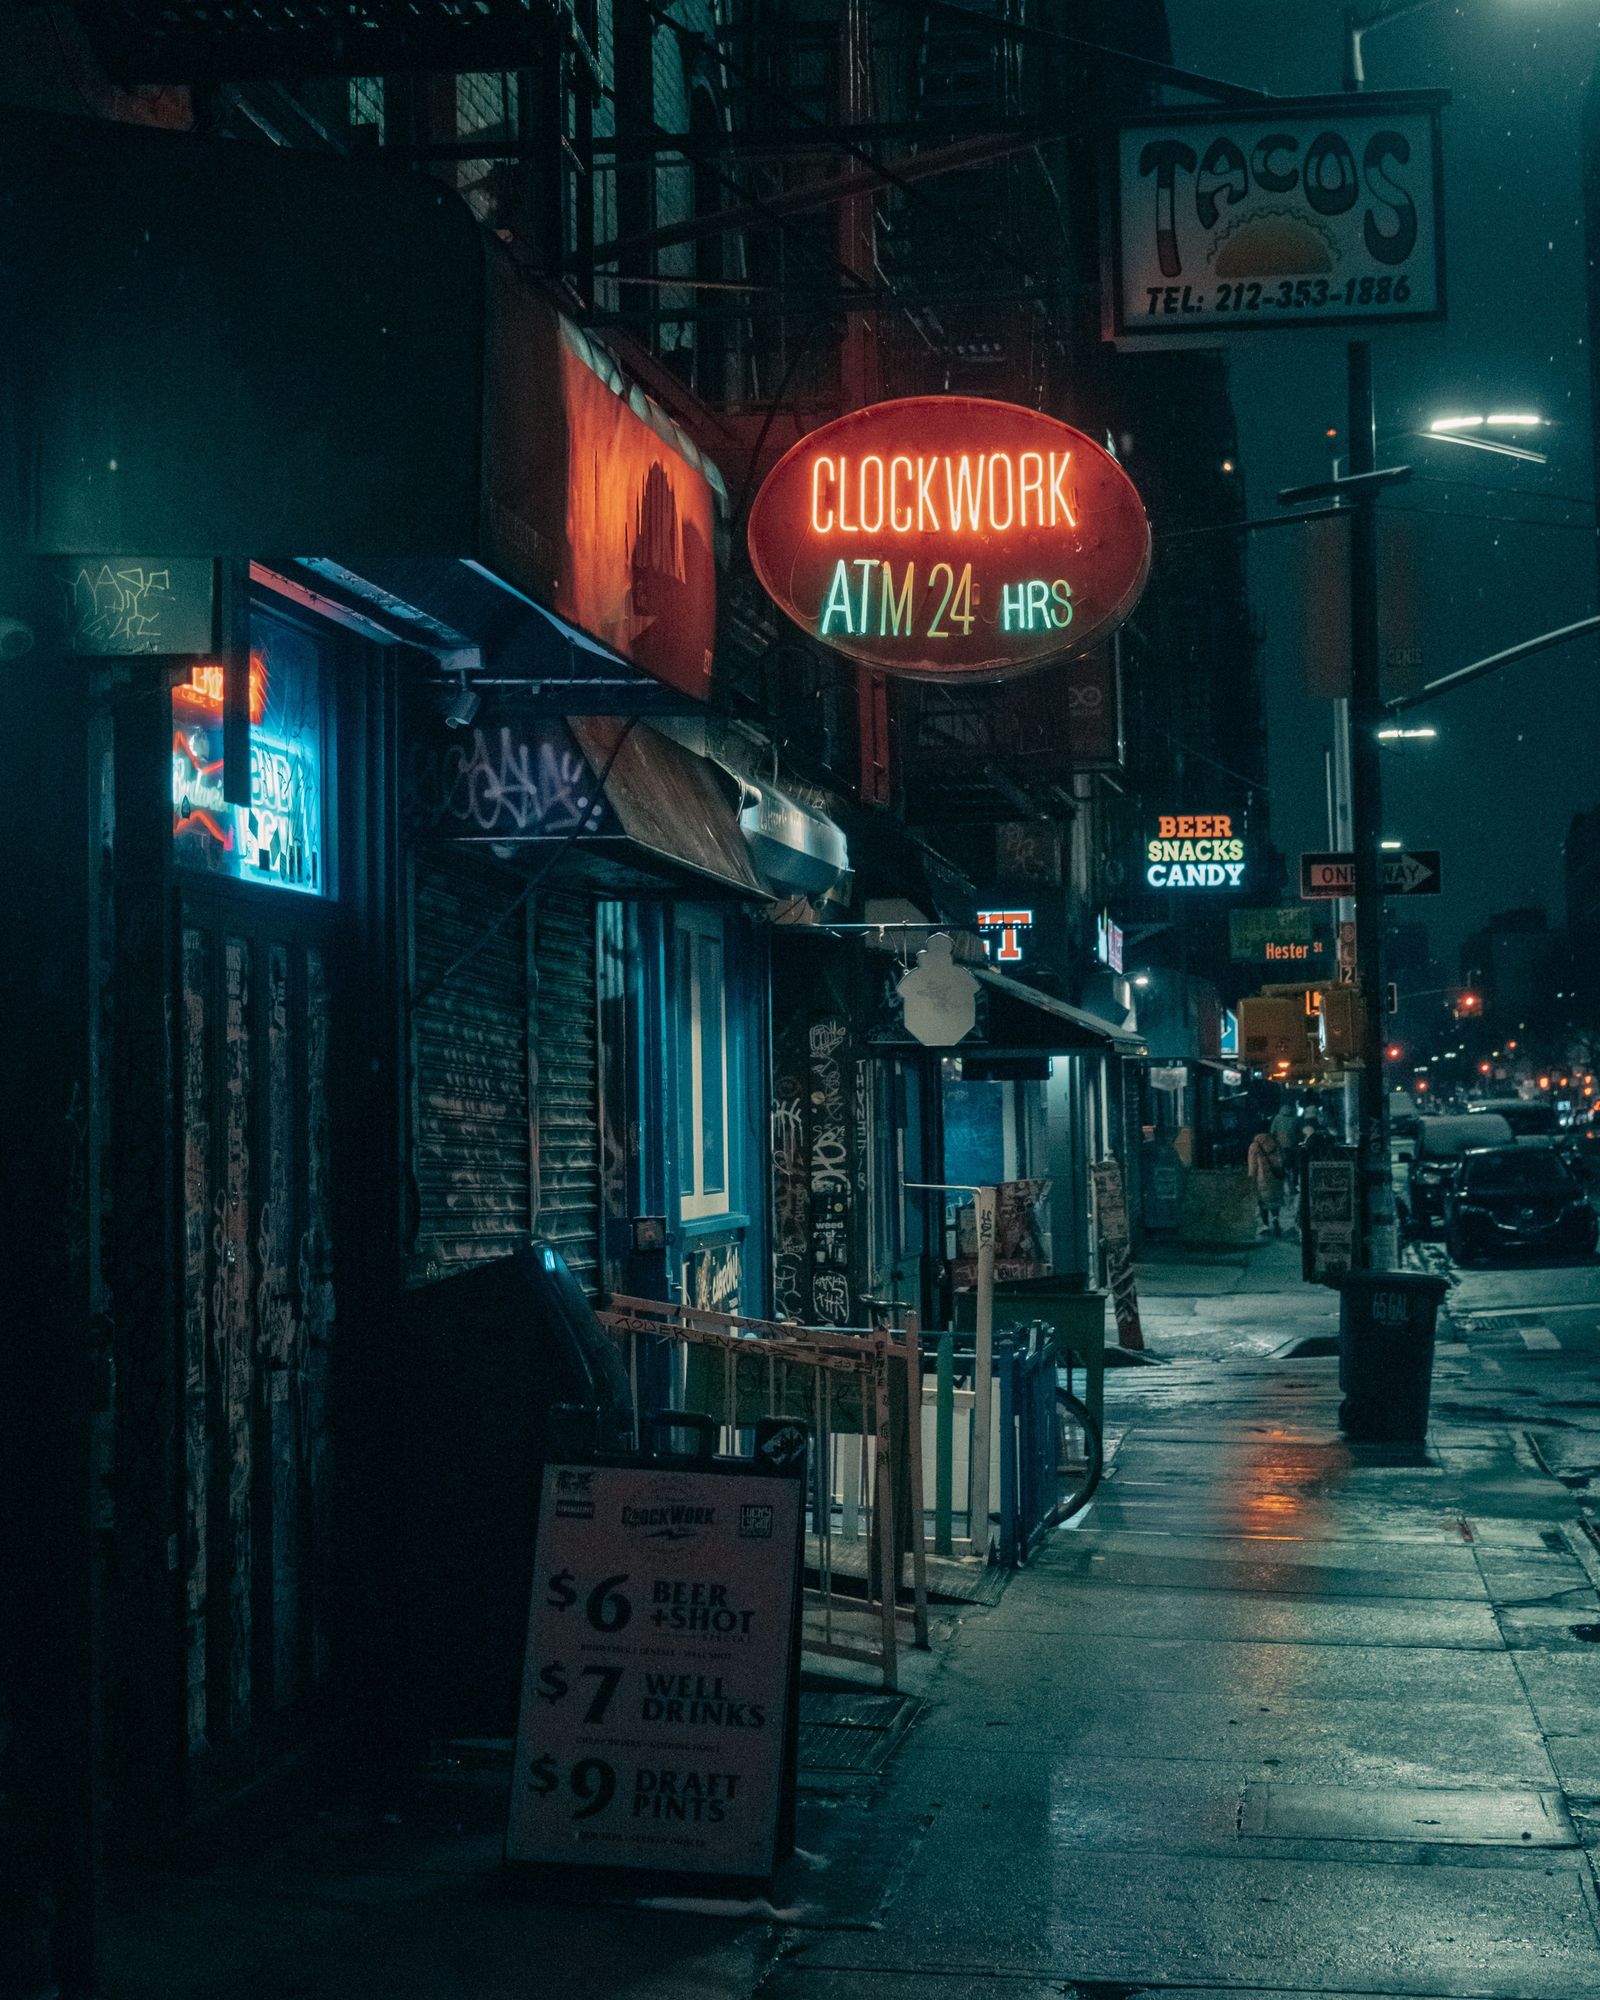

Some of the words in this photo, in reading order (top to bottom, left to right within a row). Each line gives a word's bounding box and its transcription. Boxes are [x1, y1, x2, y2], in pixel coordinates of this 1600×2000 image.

[1138, 130, 1418, 278] TACOS
[1146, 285, 1204, 315] TEL:
[1214, 274, 1411, 312] 212-353-1886
[811, 451, 1077, 534] CLOCKWORK
[820, 558, 917, 637] ATM
[926, 562, 976, 638] 24
[1002, 578, 1074, 631] HRS
[1158, 815, 1233, 838] BEER
[1148, 839, 1244, 862] SNACKS
[1146, 862, 1245, 888] CANDY
[1265, 942, 1309, 960] Hester
[621, 1504, 716, 1527] CLOCKWORK
[547, 1569, 633, 1633] $6
[652, 1580, 728, 1606] BEER
[537, 1660, 626, 1725] $7
[645, 1673, 728, 1700] WELL
[641, 1698, 766, 1728] DRINKS
[528, 1753, 617, 1821] $9
[634, 1769, 741, 1799] DRAFT
[631, 1794, 726, 1823] PINTS
